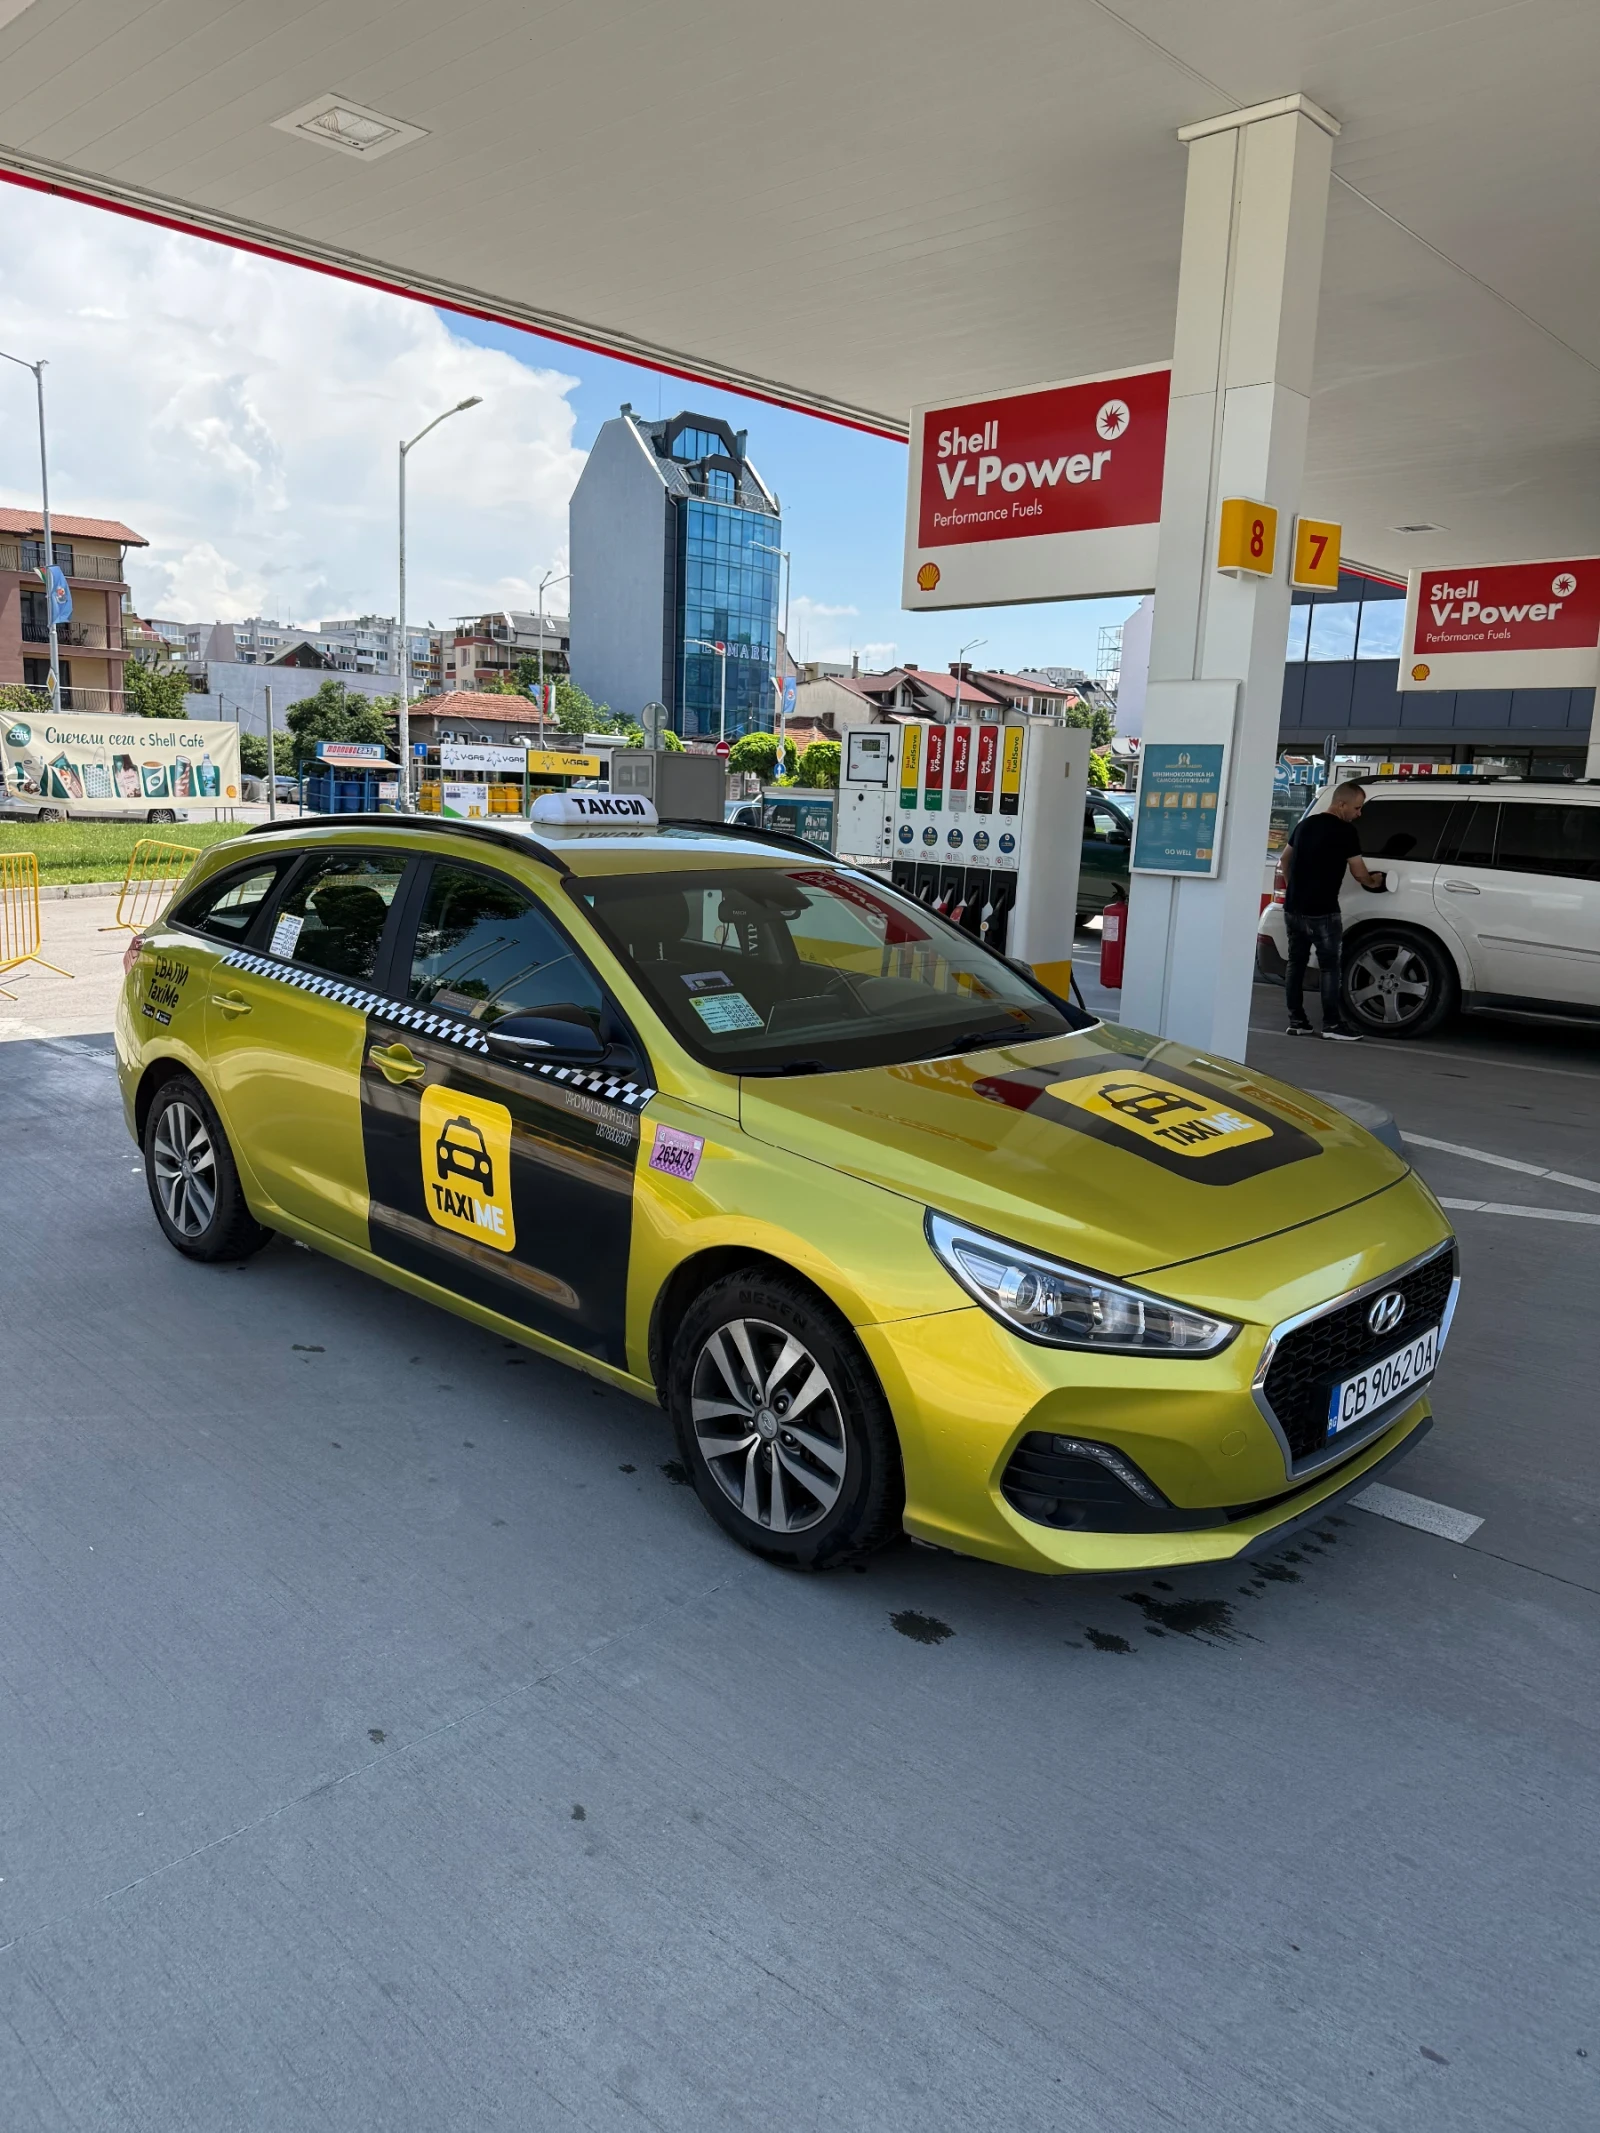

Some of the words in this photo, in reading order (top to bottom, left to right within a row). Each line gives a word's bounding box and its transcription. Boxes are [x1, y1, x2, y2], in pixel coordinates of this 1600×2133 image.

[936, 419, 999, 458] Shell
[936, 449, 1112, 500] V-Power
[933, 508, 1008, 527] Performance
[1012, 498, 1043, 518] Fuels
[1250, 519, 1264, 558] 8
[1309, 534, 1328, 570] 7
[1430, 580, 1479, 601] Shell
[1430, 602, 1563, 627] V-Power
[1426, 632, 1485, 643] Performance
[1487, 628, 1511, 640] Fuels
[45, 726, 104, 745] Спечели
[109, 733, 136, 746] сега
[149, 733, 176, 747] Shell
[180, 734, 204, 748] Café
[910, 735, 918, 769] FuelSave
[562, 758, 590, 766] V-GAS
[934, 737, 942, 772] V-Power
[959, 738, 967, 773] V-Power
[985, 739, 994, 774] V-Power
[1011, 736, 1019, 773] FuelSave
[571, 798, 646, 815] ТАКСИ
[1182, 812, 1188, 820] 3
[155, 955, 189, 987] СВАЛИ
[148, 978, 180, 1009] TaxiMe
[1152, 1111, 1256, 1147] TAXIME
[656, 1143, 695, 1172] 265478
[431, 1182, 506, 1236] TAXIME
[1342, 1376, 1368, 1422] CB
[1371, 1349, 1413, 1405] 9062
[1413, 1334, 1432, 1376] OA
